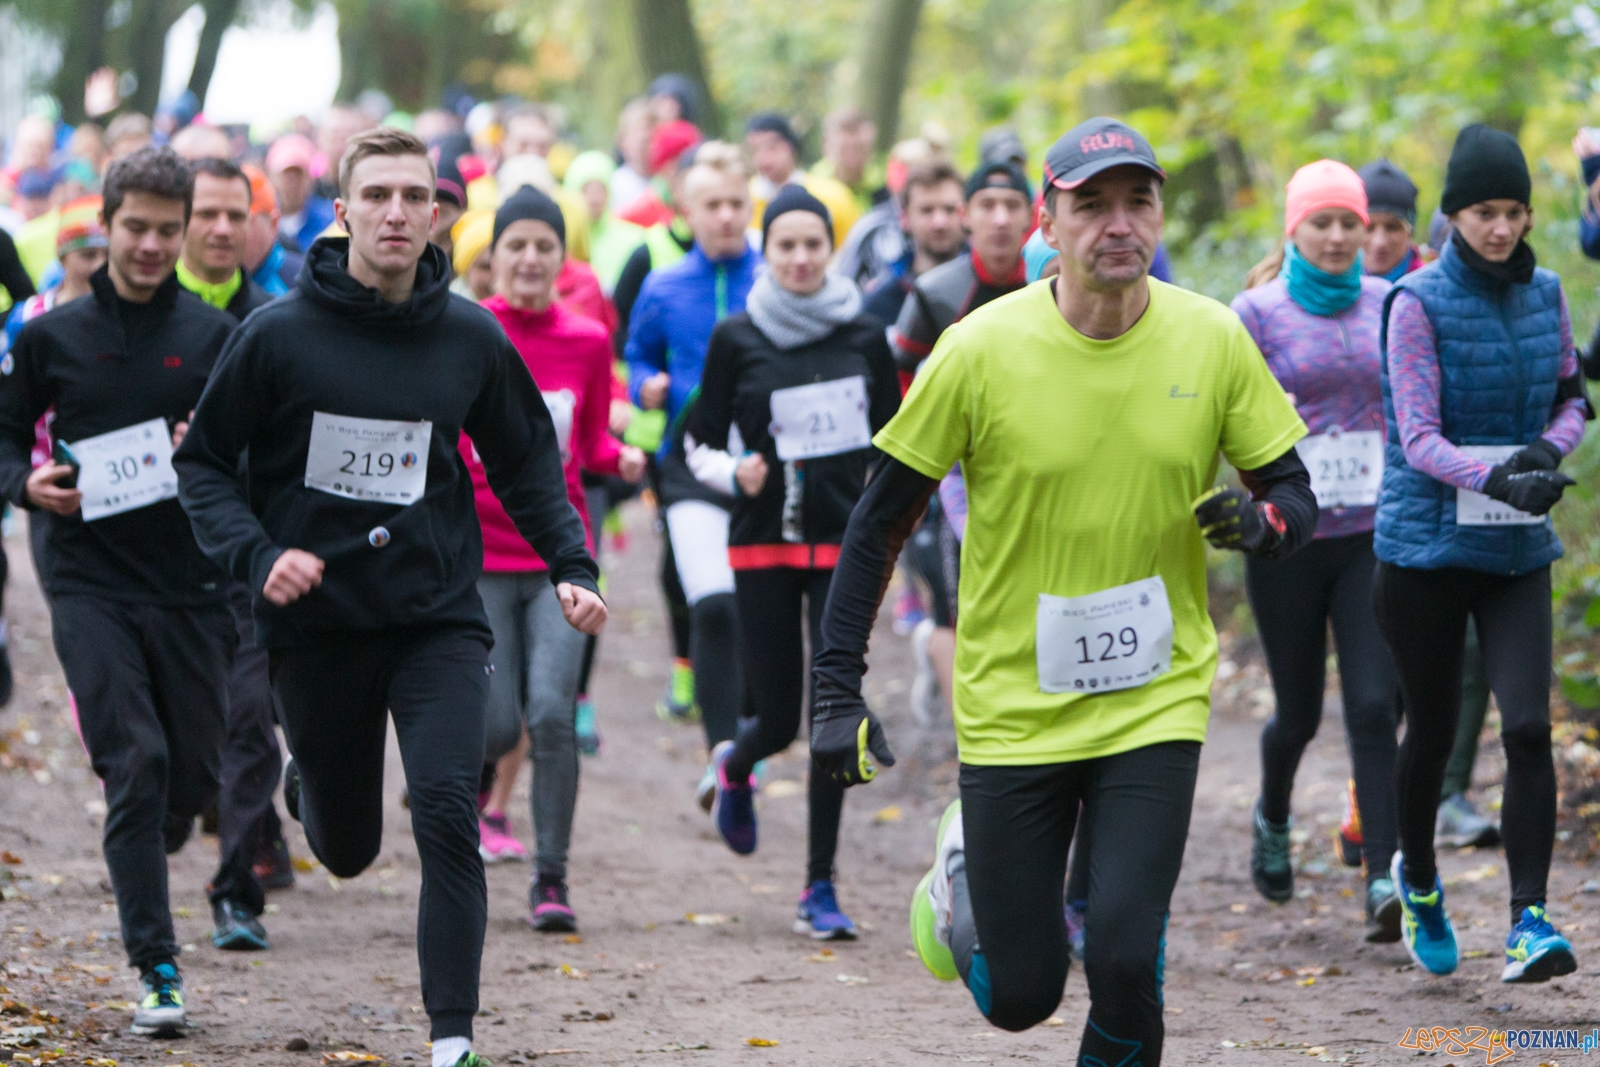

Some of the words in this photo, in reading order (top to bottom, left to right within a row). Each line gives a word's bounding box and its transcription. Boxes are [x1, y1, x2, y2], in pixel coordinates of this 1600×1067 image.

[1080, 131, 1135, 154] RUN
[807, 412, 837, 434] 21
[105, 455, 139, 485] 30
[339, 449, 395, 478] 219
[1318, 457, 1359, 481] 212
[1074, 626, 1139, 665] 129
